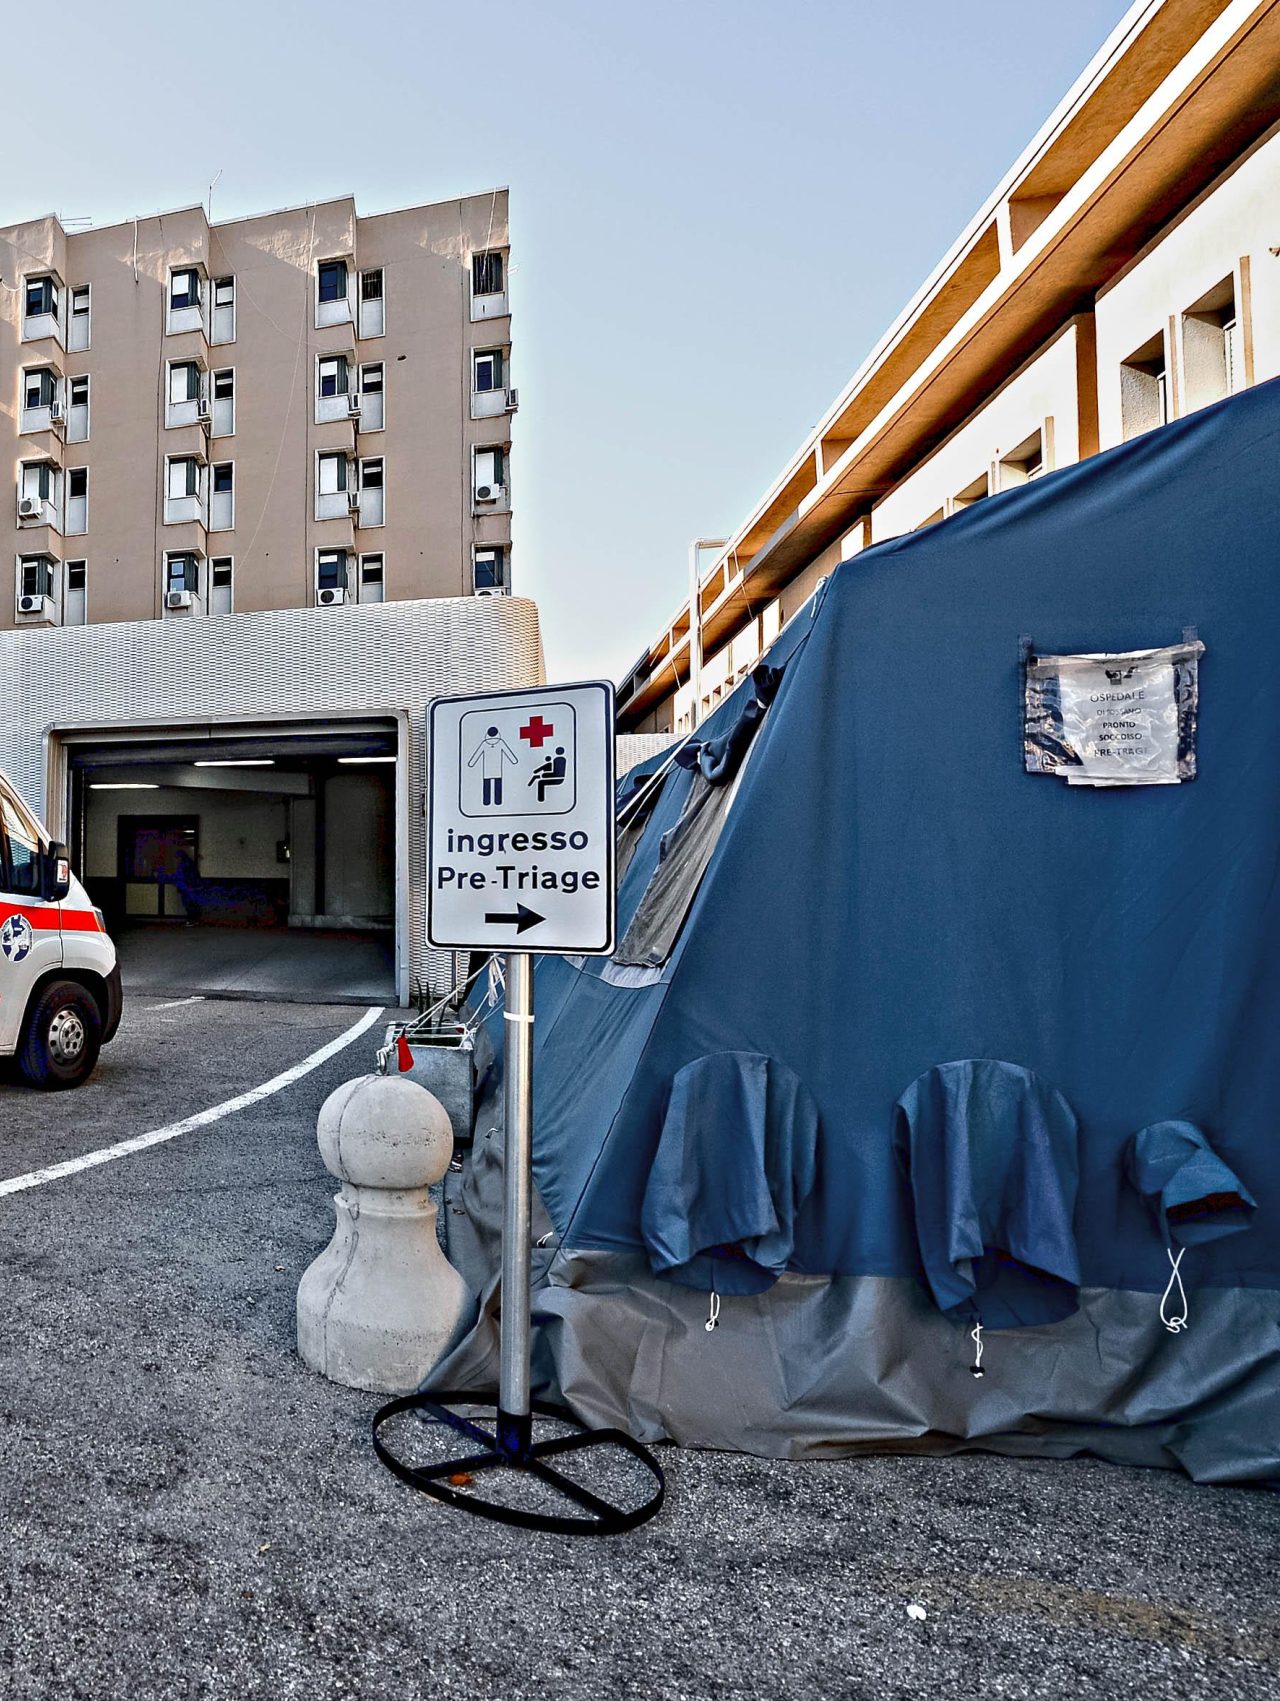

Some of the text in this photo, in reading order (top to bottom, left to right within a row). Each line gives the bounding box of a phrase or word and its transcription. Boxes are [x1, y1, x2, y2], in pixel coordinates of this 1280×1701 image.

[1090, 690, 1145, 702] OSPEDALE
[447, 828, 589, 857] ingresso
[437, 865, 600, 894] Pre-Triage
